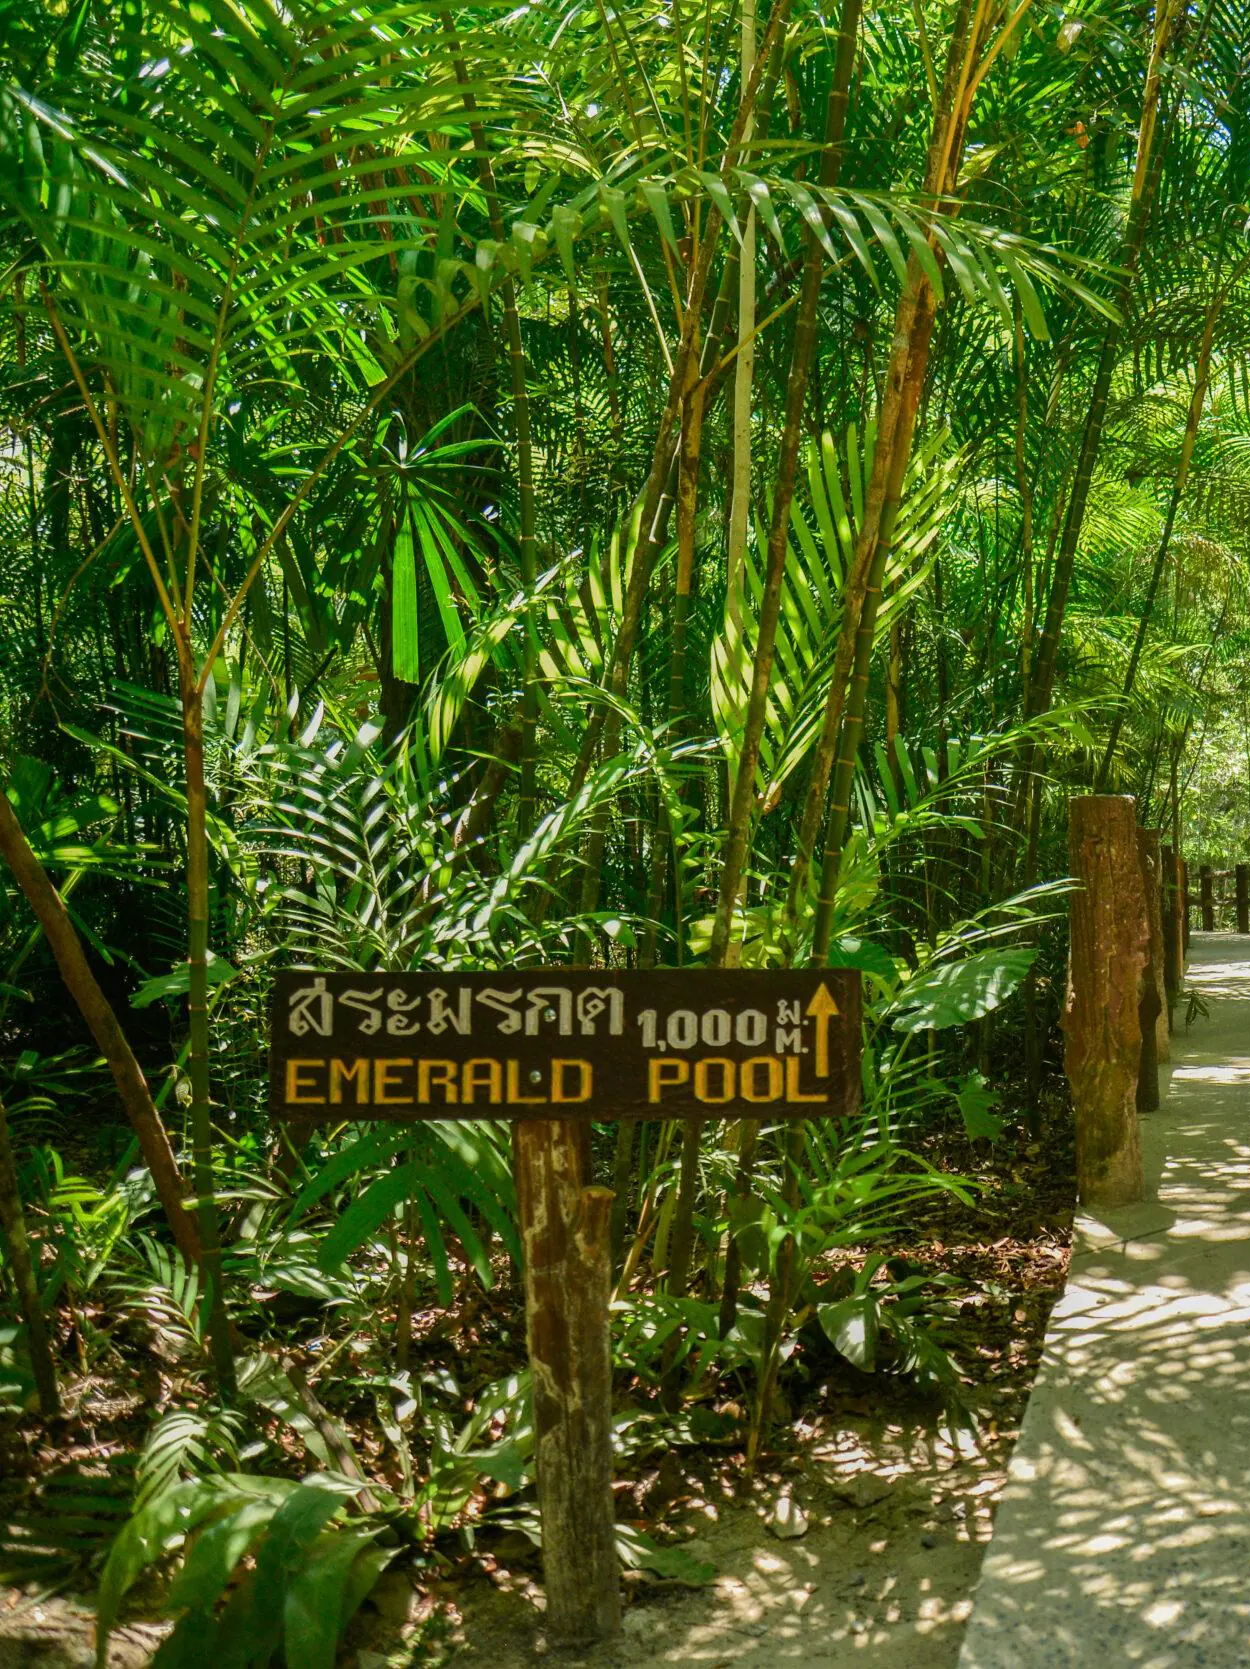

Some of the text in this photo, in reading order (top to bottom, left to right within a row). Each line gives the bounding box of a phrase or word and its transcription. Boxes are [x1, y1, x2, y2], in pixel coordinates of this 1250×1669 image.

[288, 977, 808, 1052] สระมรกต 1,000 ม.
[775, 1029, 808, 1053] M.
[285, 1057, 828, 1104] EMERALD POOL
